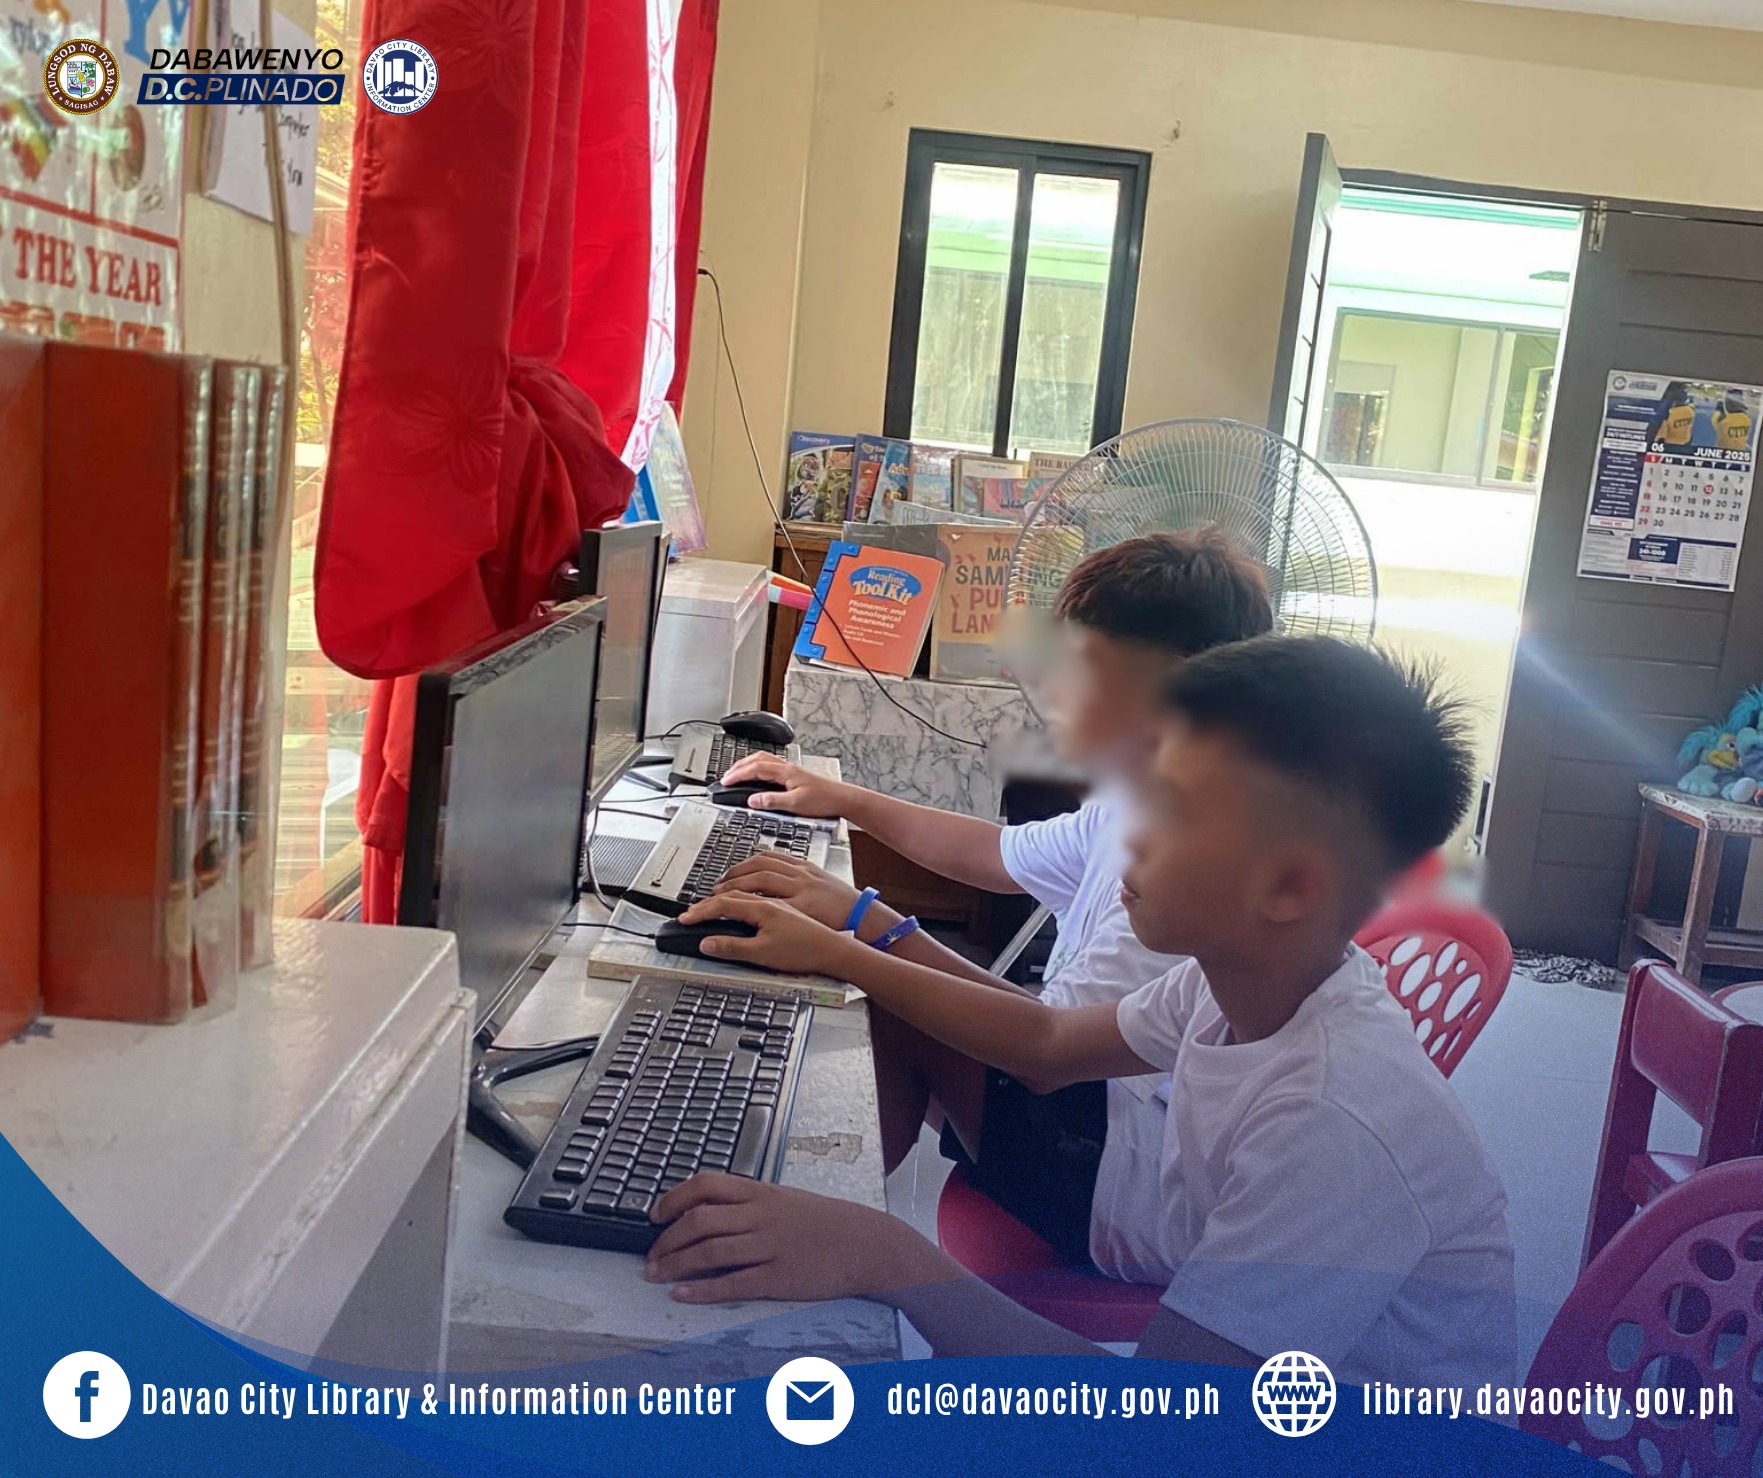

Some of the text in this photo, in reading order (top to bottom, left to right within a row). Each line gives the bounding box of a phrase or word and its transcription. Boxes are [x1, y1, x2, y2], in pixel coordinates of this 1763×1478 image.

[13, 227, 161, 307] THE YEAR
[1651, 443, 1664, 452] 06
[1694, 448, 1750, 461] JUNE 2025
[1720, 487, 1728, 495] 13
[1659, 494, 1667, 502] 16
[1674, 495, 1682, 503] 17
[1716, 500, 1727, 508] 20
[1640, 505, 1650, 513] 22
[1670, 508, 1680, 516] 24
[1699, 511, 1710, 519] 26
[1729, 514, 1739, 522] 28
[987, 547, 1013, 562] MA
[868, 569, 905, 585] Reading
[848, 600, 907, 616] Phonemic and
[848, 608, 902, 623] Phonological
[850, 616, 894, 629] Awareness
